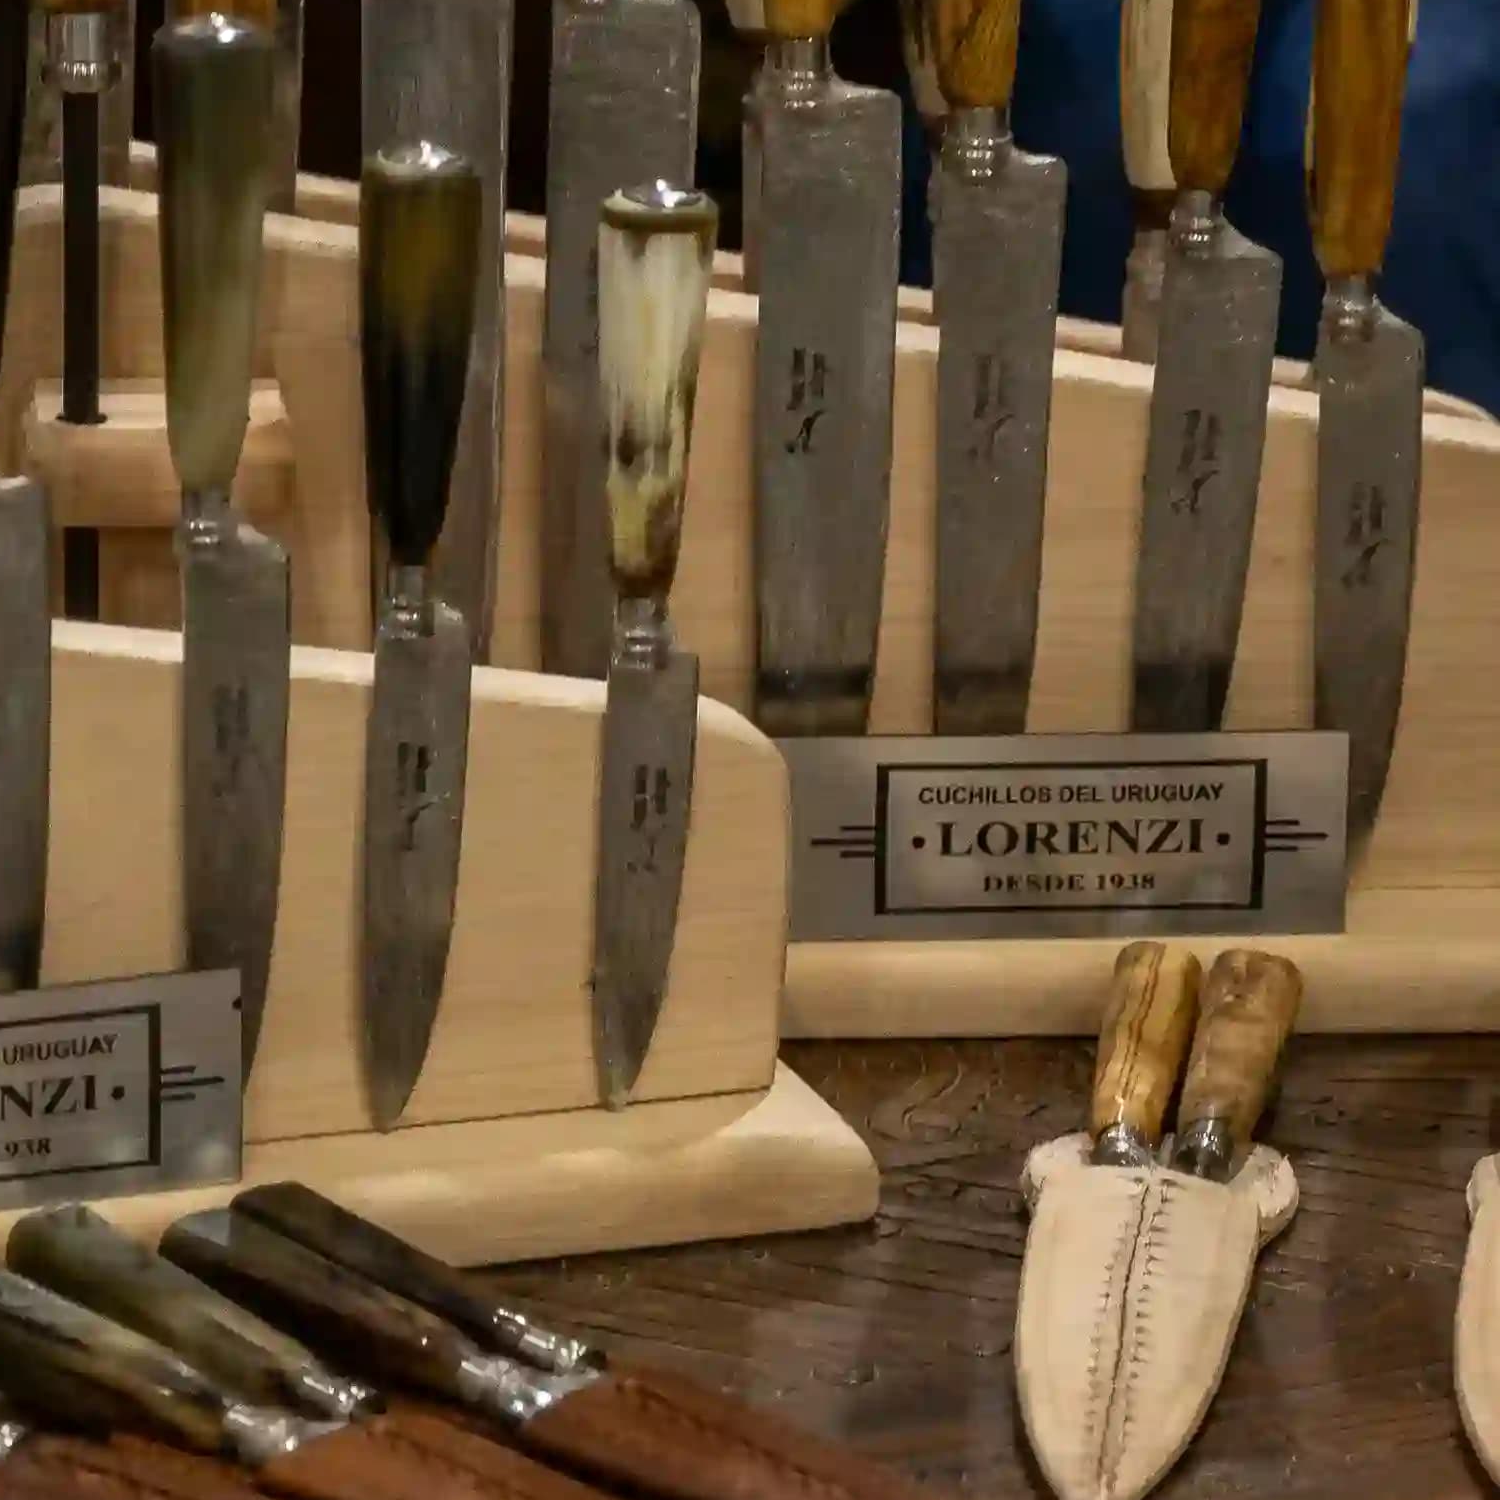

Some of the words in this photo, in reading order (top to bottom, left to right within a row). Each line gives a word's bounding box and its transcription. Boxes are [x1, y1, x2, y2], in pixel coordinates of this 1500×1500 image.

[918, 784, 1052, 805] CUCHILLOS
[1059, 784, 1105, 803] DEL
[1112, 781, 1224, 803] URUGUAY
[938, 818, 1204, 857] LORENZI
[983, 873, 1084, 894] DESDE
[1097, 872, 1156, 891] 1938
[2, 1033, 118, 1065] URUGUAY
